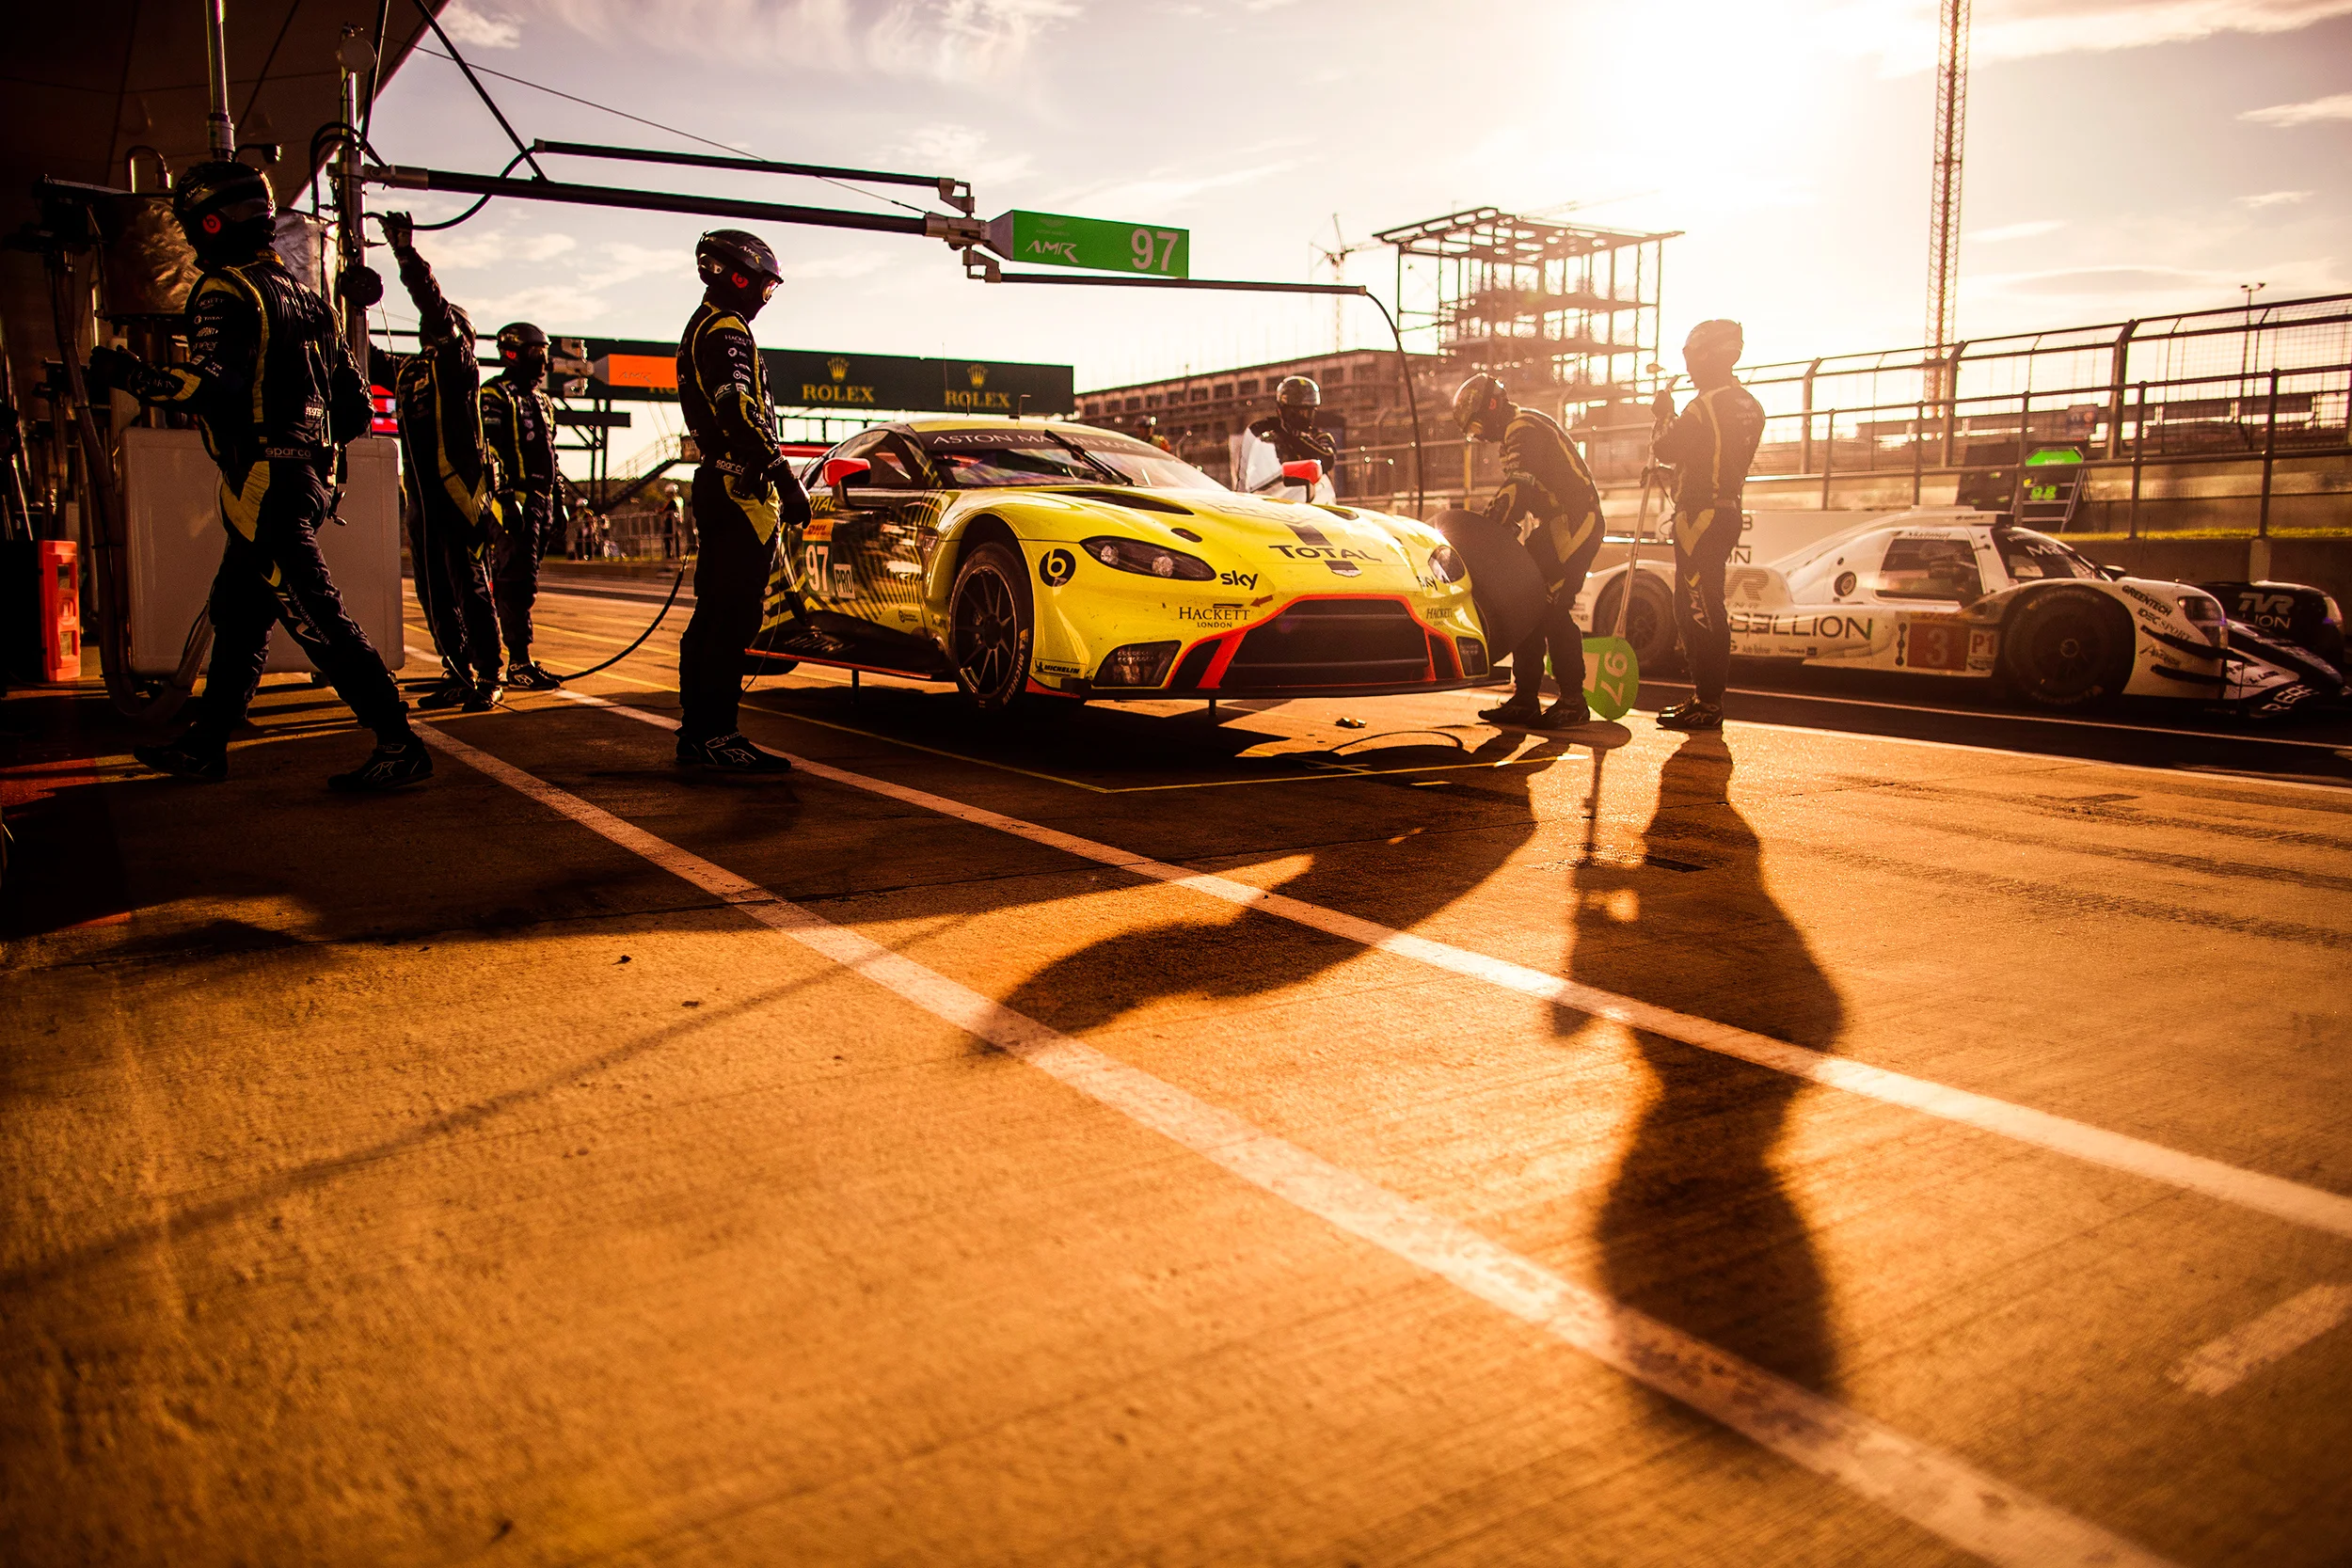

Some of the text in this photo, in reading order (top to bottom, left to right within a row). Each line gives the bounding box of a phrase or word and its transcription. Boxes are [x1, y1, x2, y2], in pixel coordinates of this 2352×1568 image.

[1025, 240, 1079, 263] AMR
[1131, 229, 1179, 272] 97
[802, 384, 875, 404] ROLEX
[944, 389, 1011, 408] ROLEX
[933, 434, 1011, 445] ASTON
[1018, 434, 1098, 449] MATIN
[265, 446, 312, 459] sparco
[810, 497, 836, 513] OTAL
[1268, 545, 1383, 563] TOTAL
[805, 544, 830, 592] 97
[834, 569, 854, 594] PRO
[1219, 570, 1259, 591] sky
[2122, 584, 2172, 617] GREENTECH
[2238, 592, 2295, 615] TVR
[1179, 607, 1250, 621] HACKETT
[1926, 626, 1948, 667] 3
[1971, 634, 1995, 656] P1
[1043, 663, 1081, 674] MICHELIN
